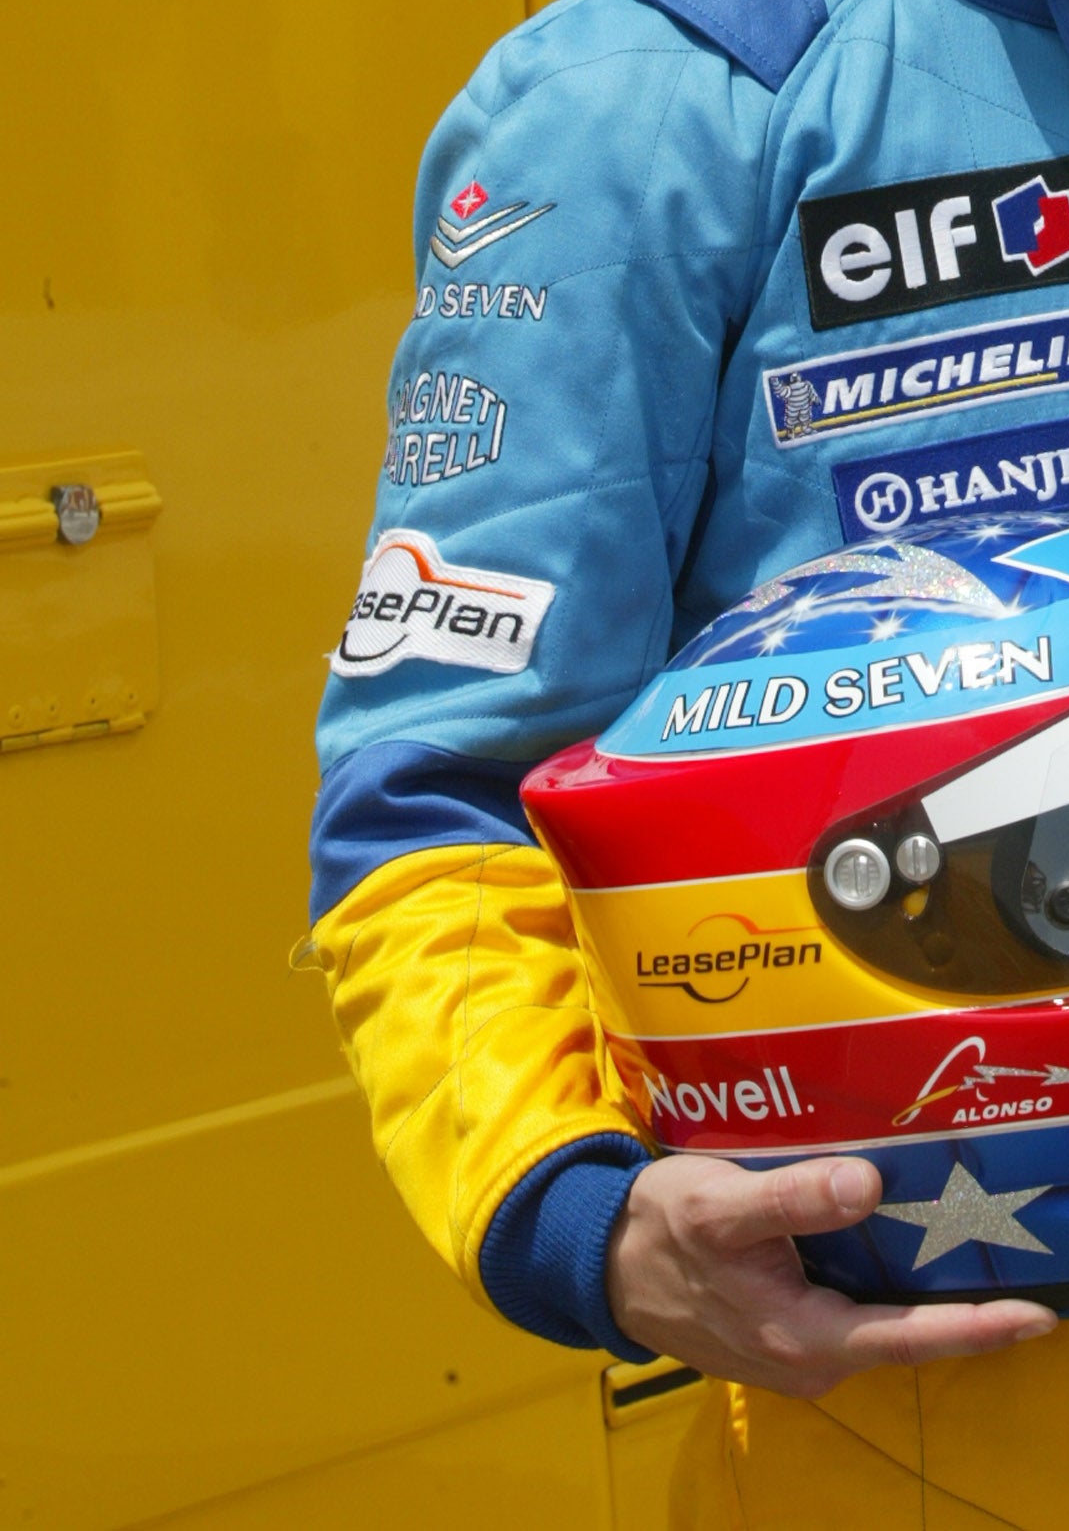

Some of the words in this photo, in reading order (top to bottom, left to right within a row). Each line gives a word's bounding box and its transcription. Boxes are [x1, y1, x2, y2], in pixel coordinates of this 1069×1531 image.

[820, 196, 978, 302] elf
[439, 283, 547, 321] SEVEN
[660, 675, 809, 742] MILD
[823, 635, 1053, 718] SEVEN
[636, 941, 822, 978] LeasePlan
[951, 1095, 1054, 1125] ALONSO
